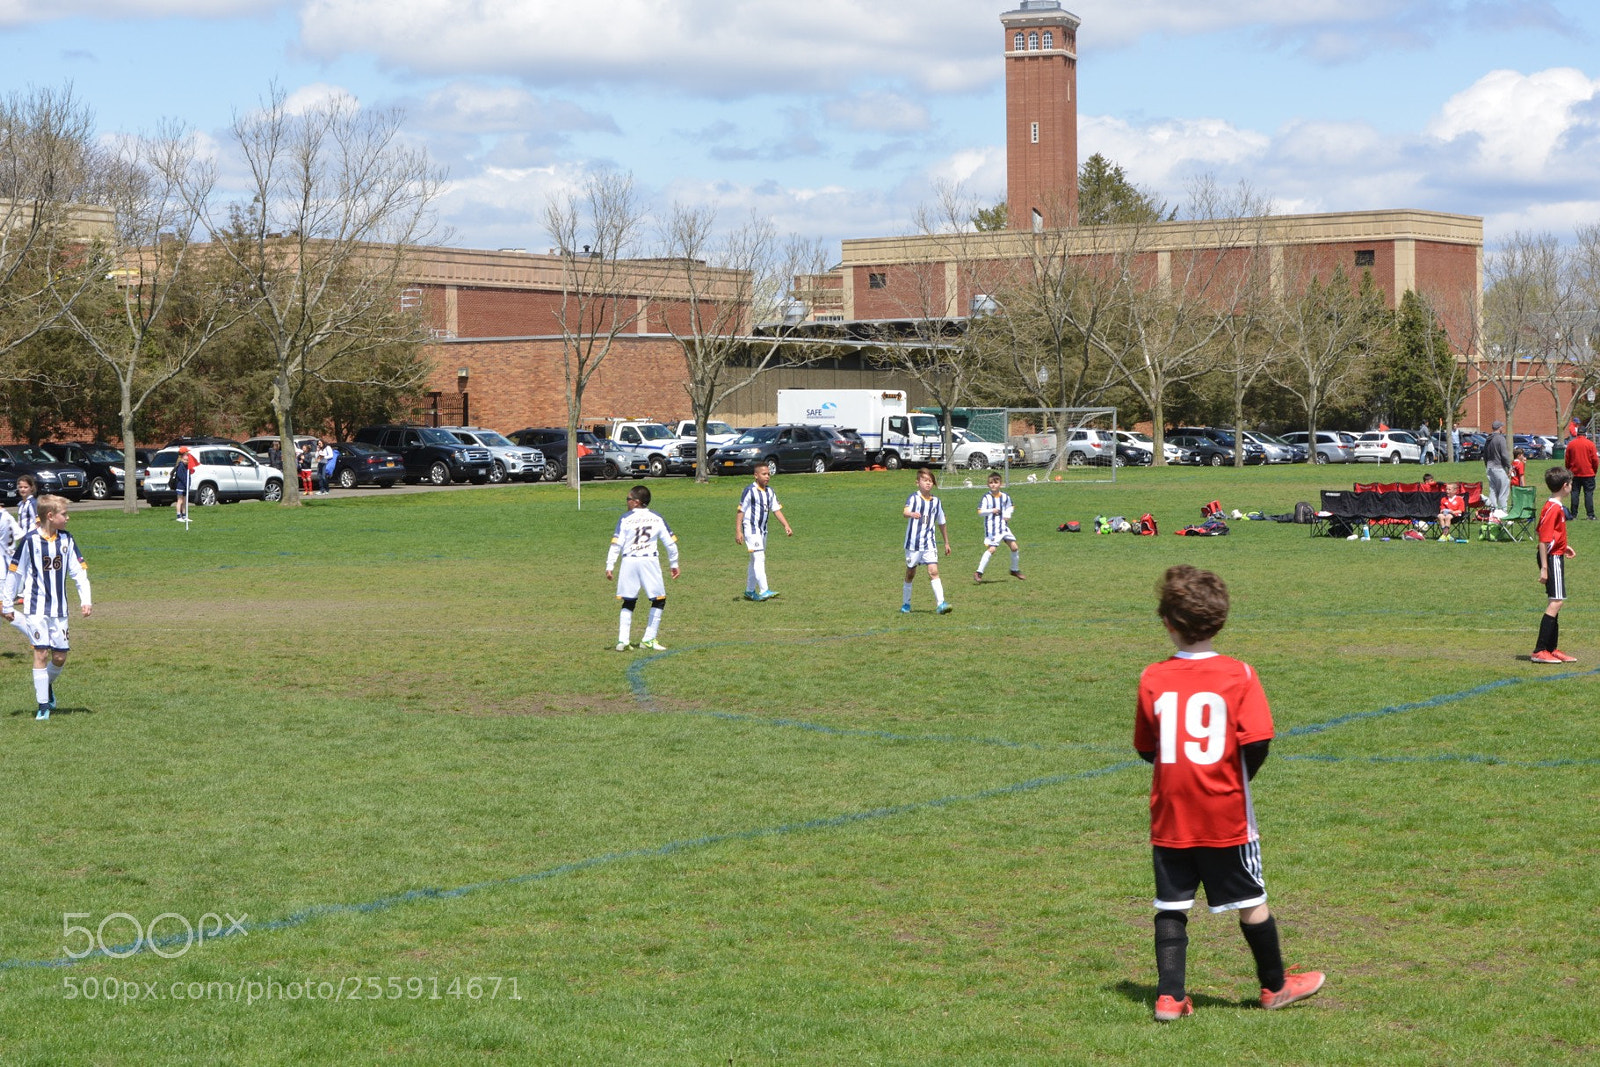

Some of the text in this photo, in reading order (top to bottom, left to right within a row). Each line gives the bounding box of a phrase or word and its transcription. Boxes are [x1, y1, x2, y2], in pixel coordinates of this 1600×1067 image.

[806, 408, 822, 416] SAFE
[633, 525, 652, 545] 15
[43, 556, 62, 572] 26
[1153, 691, 1227, 765] 19
